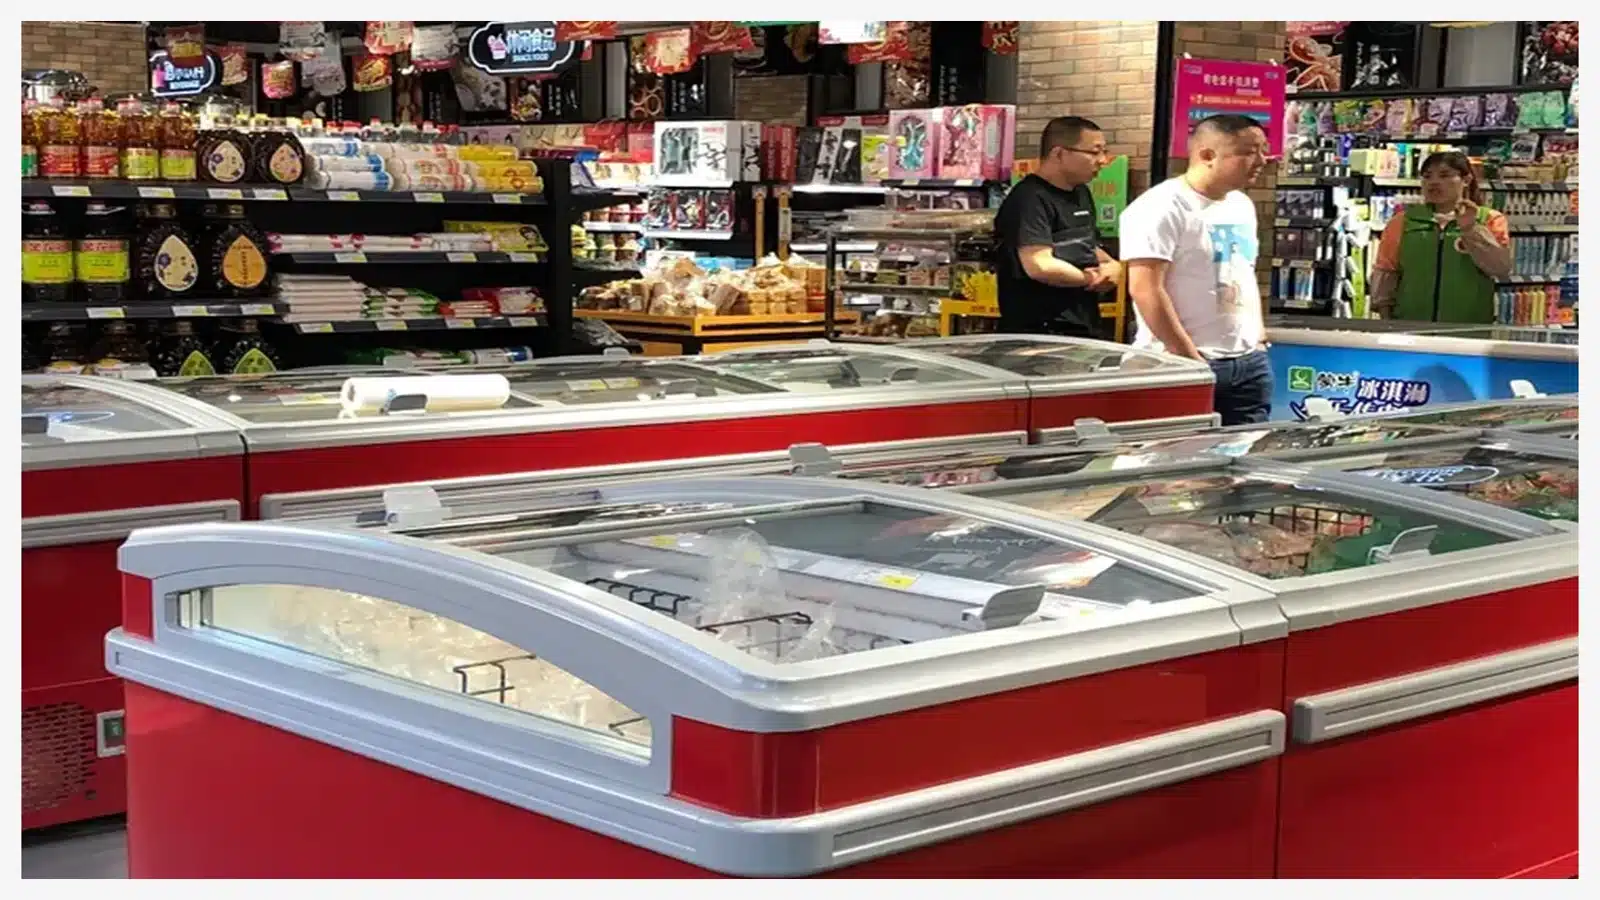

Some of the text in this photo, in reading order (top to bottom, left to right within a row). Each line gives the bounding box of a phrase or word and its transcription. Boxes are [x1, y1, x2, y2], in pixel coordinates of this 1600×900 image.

[506, 28, 556, 53] 休闲食品
[1317, 371, 1354, 389] 蒙牛
[1357, 379, 1427, 403] 冰淇淋
